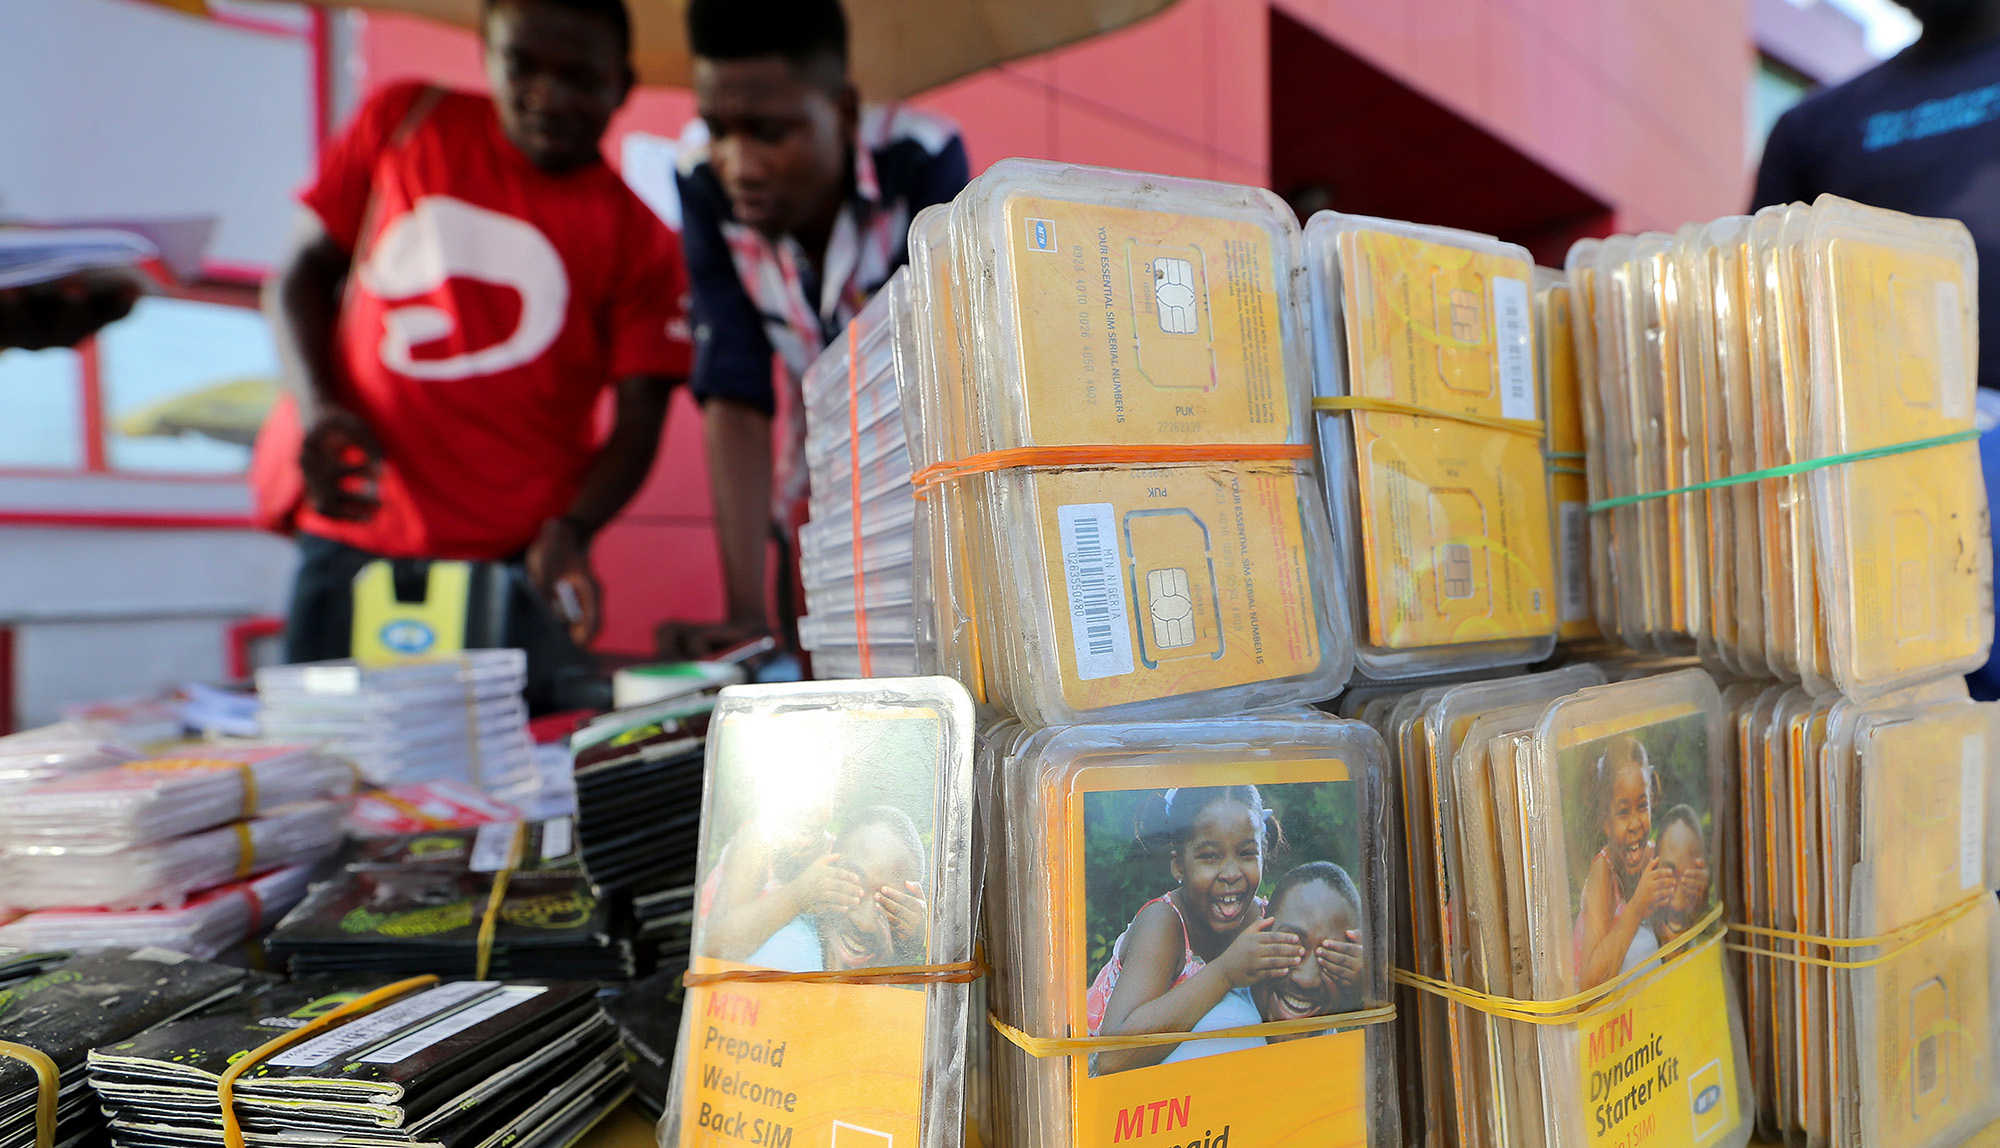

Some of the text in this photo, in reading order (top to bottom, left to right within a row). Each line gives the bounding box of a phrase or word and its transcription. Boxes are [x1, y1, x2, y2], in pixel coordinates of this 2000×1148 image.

[1037, 224, 1046, 248] MTN
[1144, 263, 1150, 273] 2
[1078, 311, 1091, 338] 0026
[1098, 226, 1126, 423] YOUR ESSENTIAL SIM SERIAL NUMBER IS
[1176, 405, 1195, 416] PUK
[1147, 487, 1168, 498] PUK
[1066, 552, 1086, 617] 0263550480
[1103, 548, 1121, 620] MTN NIGERIA
[1230, 478, 1264, 664] YOUR ESSENTIAL SIM SERIAL NUMBER IS
[706, 991, 760, 1026] MTN
[704, 1026, 786, 1068] Prepaid
[1589, 1008, 1633, 1068] MTN
[703, 1064, 797, 1112] Welcome
[1590, 1033, 1663, 1103] Dynamic
[1113, 1095, 1191, 1144] MTN
[1596, 1056, 1679, 1137] Starter Kit
[699, 1102, 793, 1148] Back SIM
